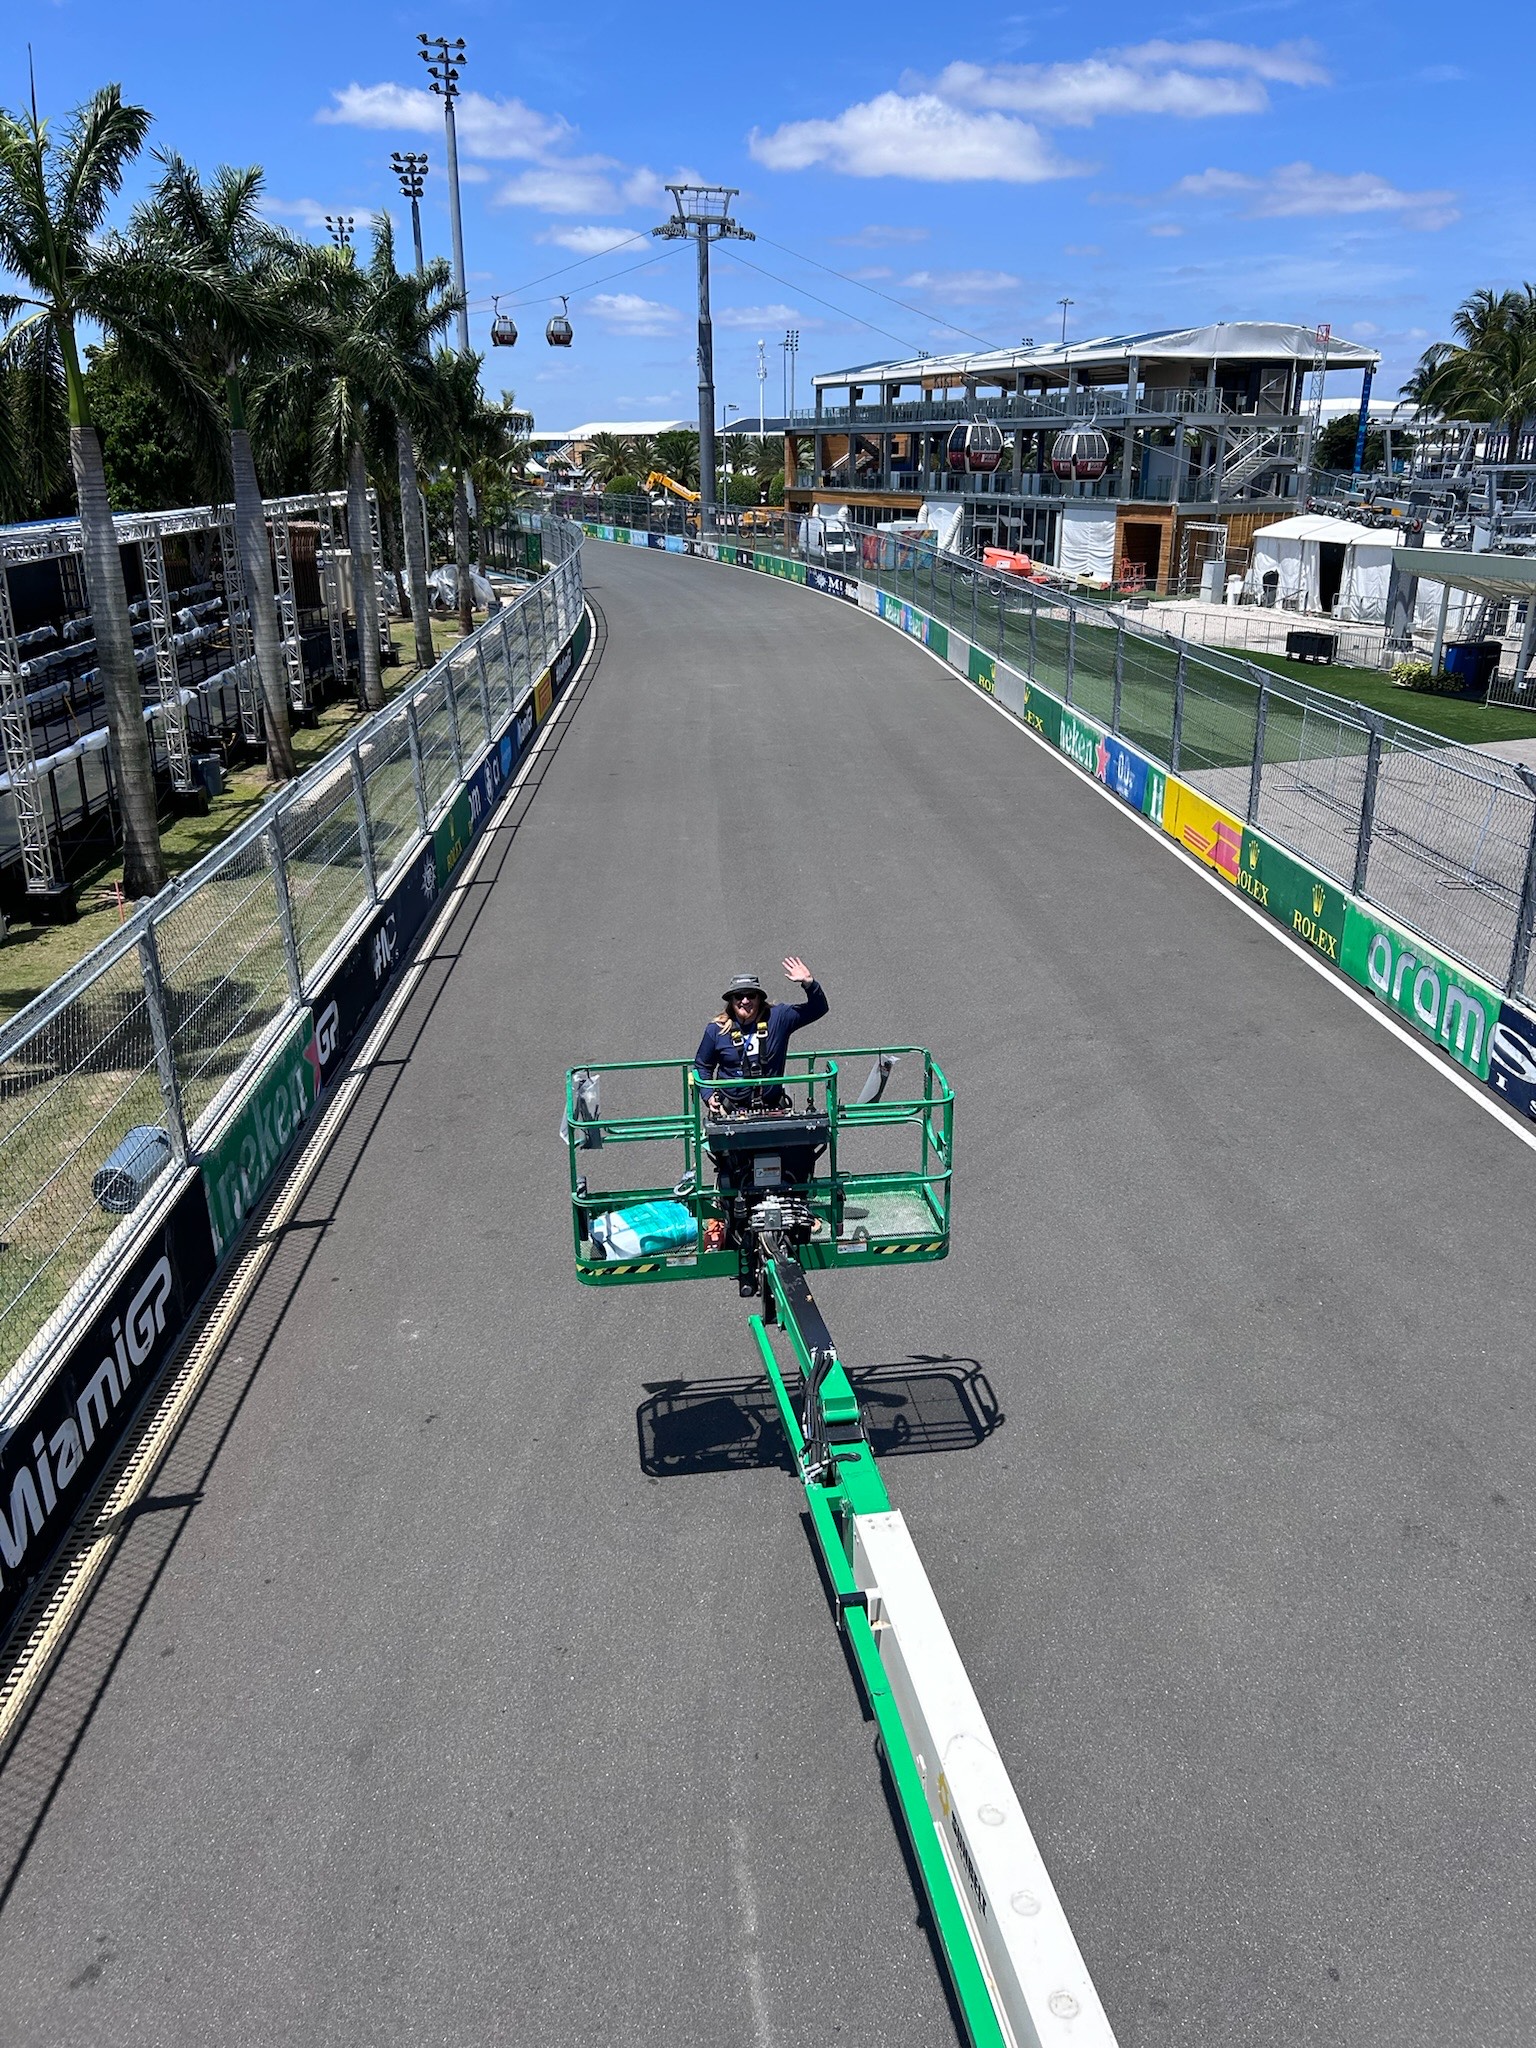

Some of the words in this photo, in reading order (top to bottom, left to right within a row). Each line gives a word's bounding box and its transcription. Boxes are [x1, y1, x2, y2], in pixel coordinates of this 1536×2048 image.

[1024, 709, 1044, 733] EX
[1292, 908, 1338, 960] ROLEX
[315, 999, 339, 1066] GP
